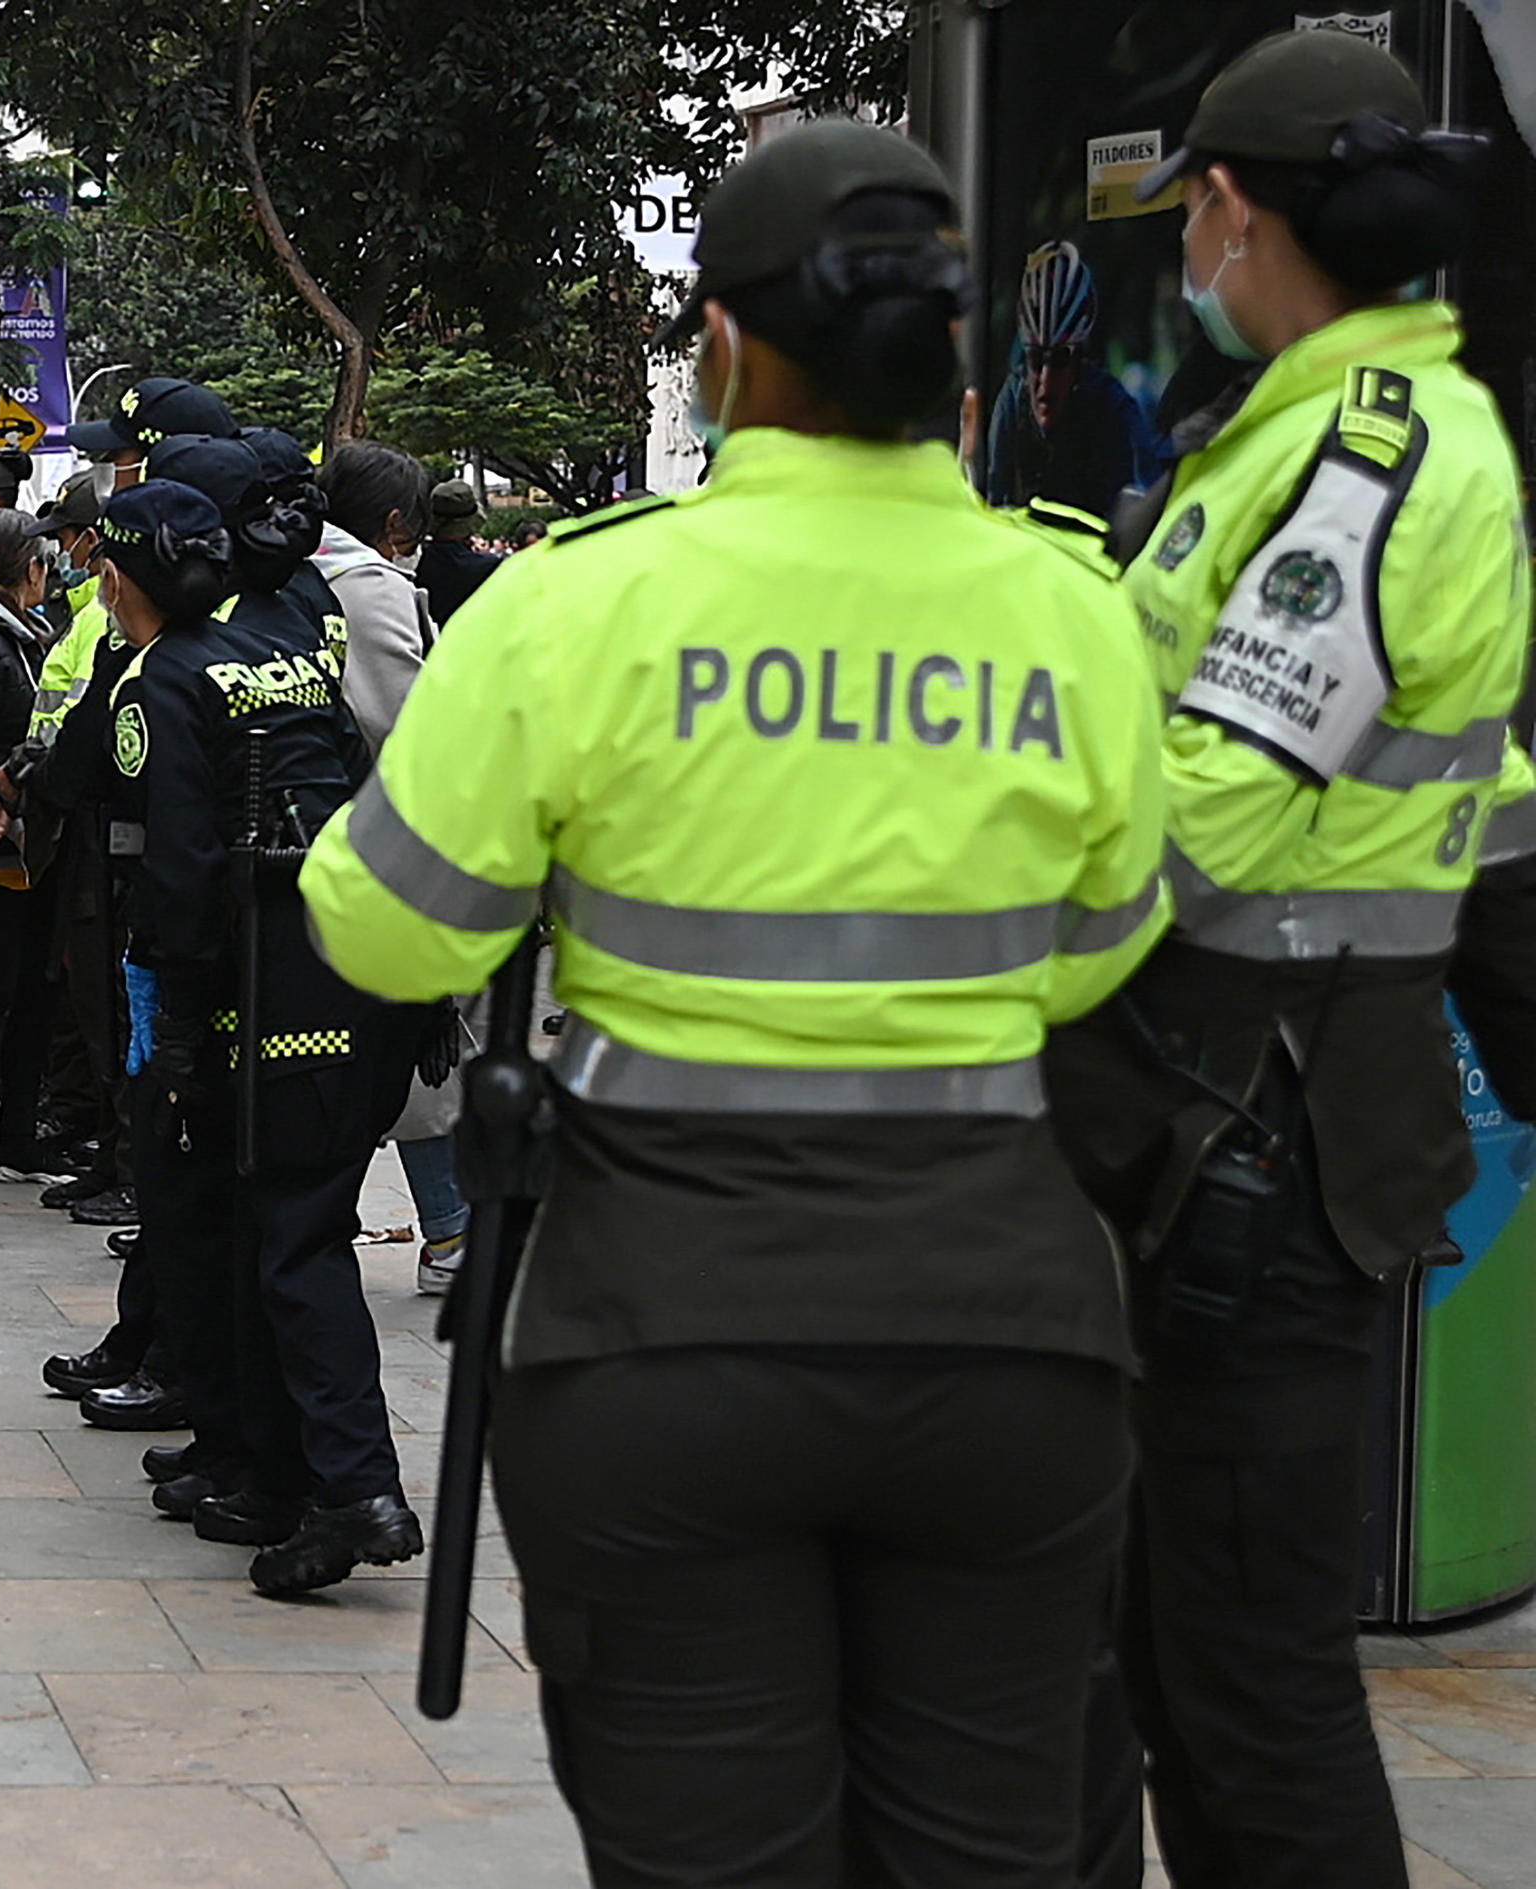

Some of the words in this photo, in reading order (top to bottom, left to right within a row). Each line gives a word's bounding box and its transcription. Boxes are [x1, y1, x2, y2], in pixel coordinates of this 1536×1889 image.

[1092, 143, 1155, 165] FIADORES
[1320, 673, 1341, 701] Y
[675, 647, 1064, 760] POLICIA
